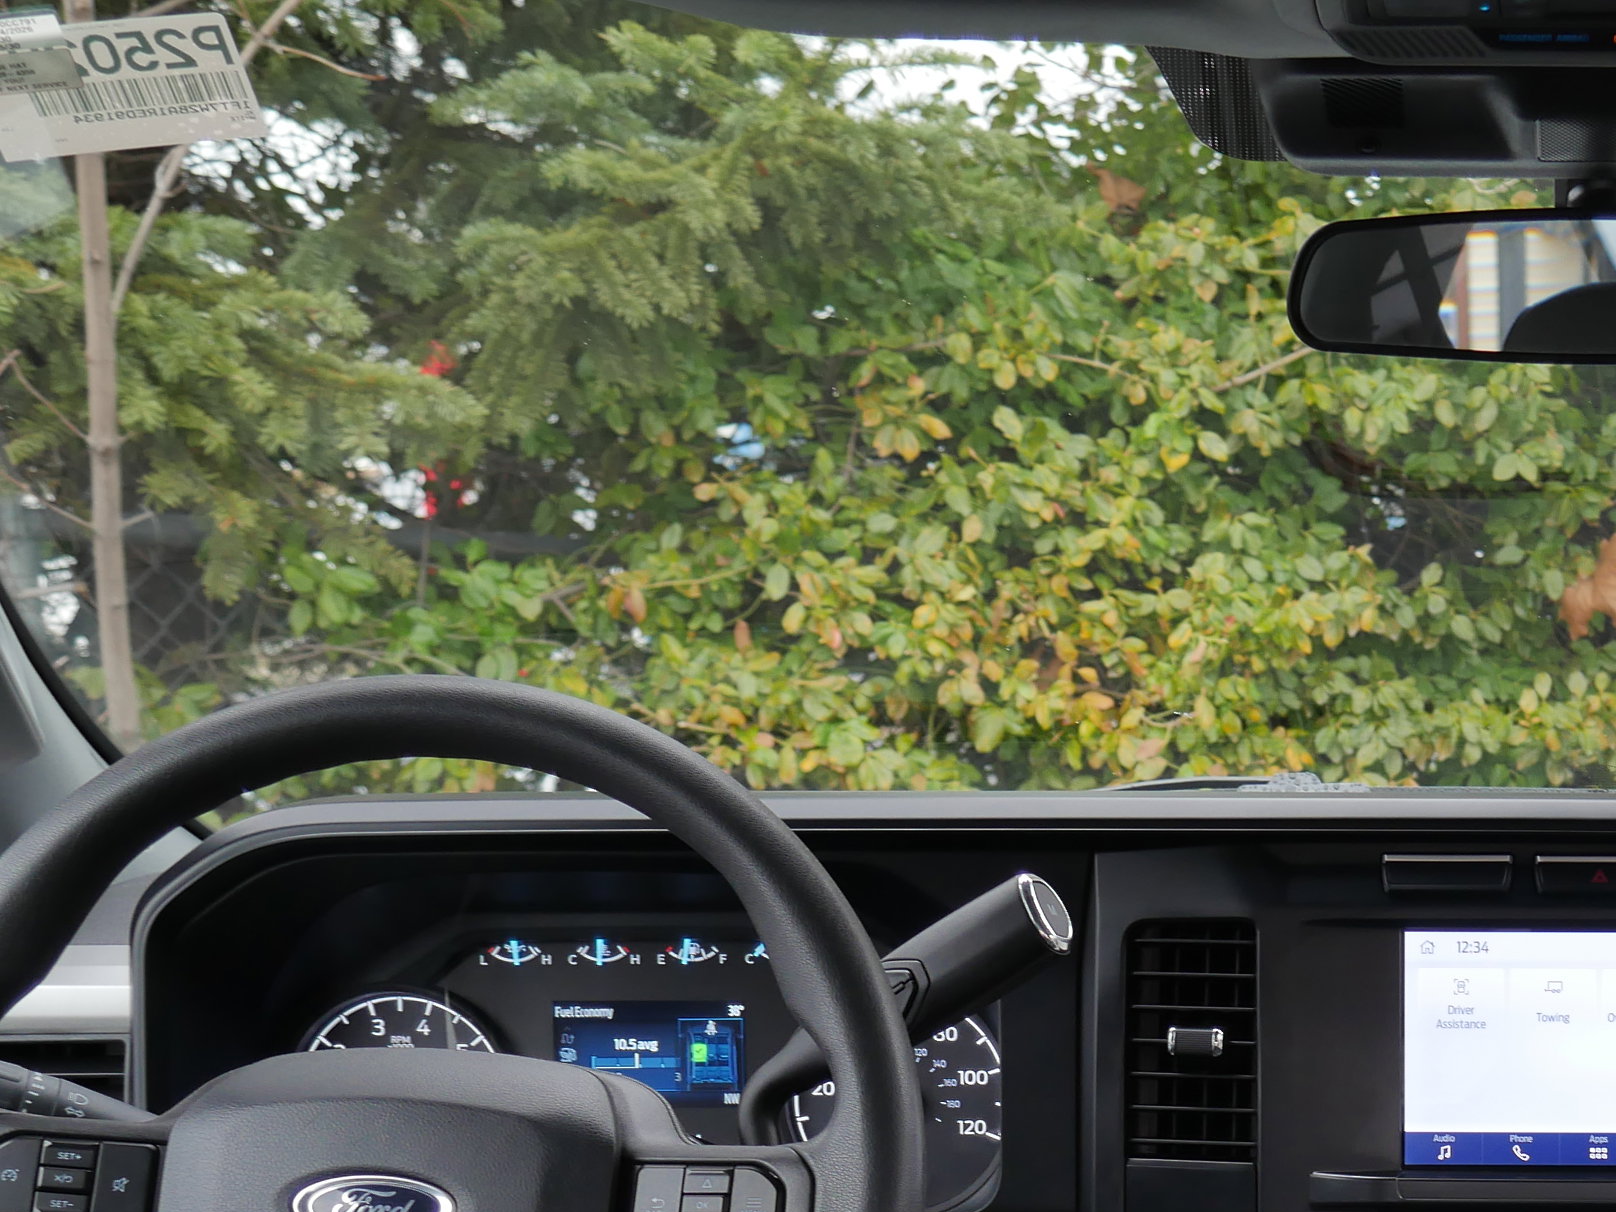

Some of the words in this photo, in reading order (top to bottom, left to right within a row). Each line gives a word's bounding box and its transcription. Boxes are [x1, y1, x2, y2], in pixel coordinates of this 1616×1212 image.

[1456, 941, 1490, 954] 12:34
[479, 956, 488, 965] L
[541, 956, 552, 965] H
[567, 956, 578, 965] C
[629, 956, 641, 965] H
[656, 956, 666, 965] E
[718, 956, 728, 965] F
[744, 956, 755, 965] C
[1447, 1004, 1475, 1015] Driver
[1436, 1018, 1486, 1029] Assistance
[1536, 1012, 1570, 1024] Towing
[371, 1019, 386, 1036] 3
[416, 1019, 431, 1036] 4
[613, 1038, 637, 1051] 10.5
[957, 1070, 989, 1085] 100
[724, 1093, 741, 1105] NW
[956, 1119, 987, 1136] 120
[1433, 1134, 1456, 1144] Audio
[1509, 1134, 1533, 1144] Phone
[1589, 1134, 1609, 1146] Apps
